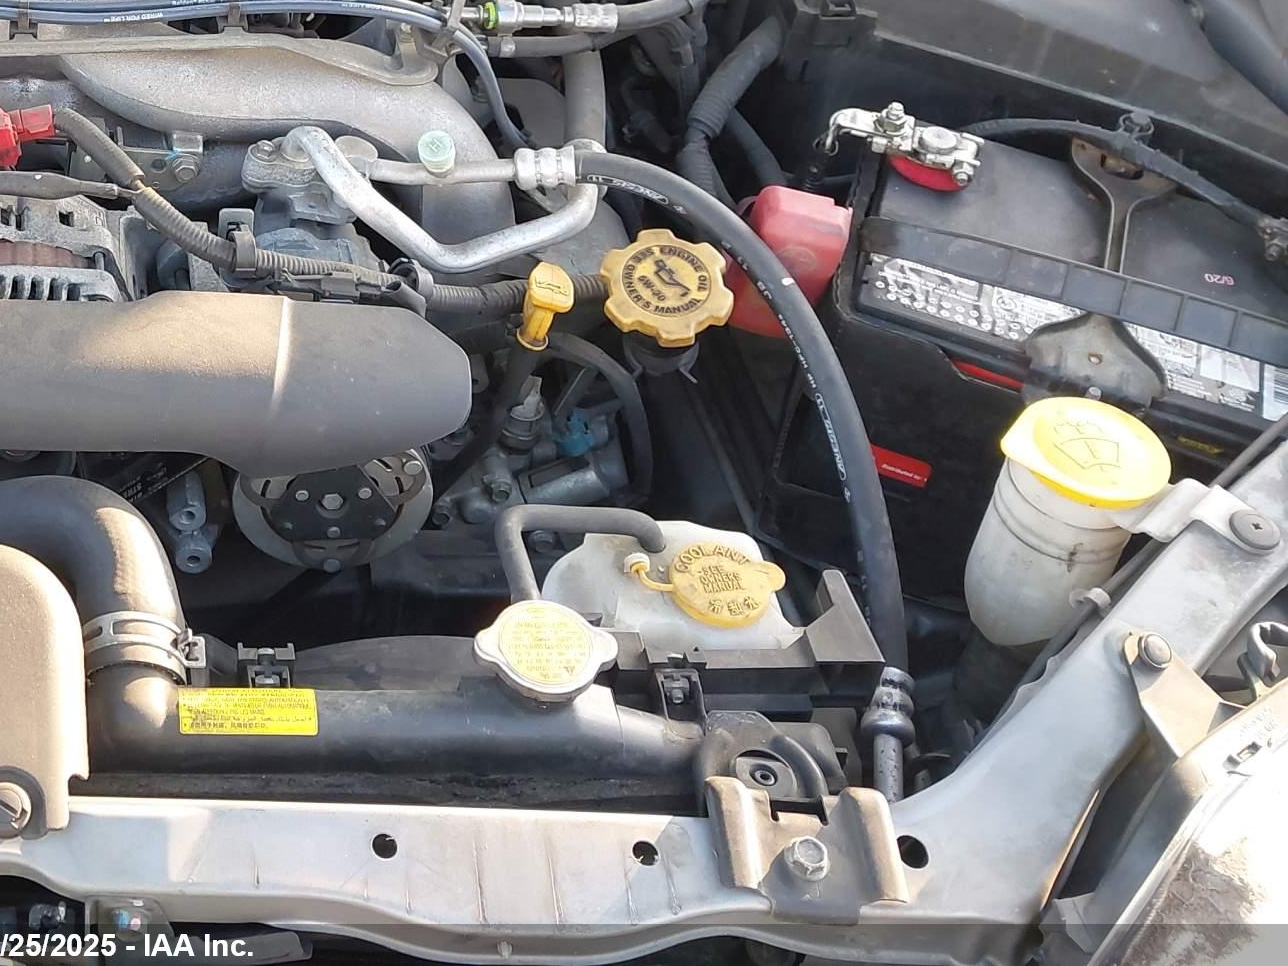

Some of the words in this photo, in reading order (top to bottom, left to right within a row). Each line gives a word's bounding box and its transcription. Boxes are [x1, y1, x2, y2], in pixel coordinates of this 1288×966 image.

[632, 247, 654, 263] SEE
[659, 246, 704, 273] ENGINE
[697, 274, 709, 292] OIL
[623, 264, 651, 309] OWNER'S
[653, 297, 703, 314] MANUAL
[674, 544, 751, 573] COOLANT
[703, 581, 744, 594] MANUAL
